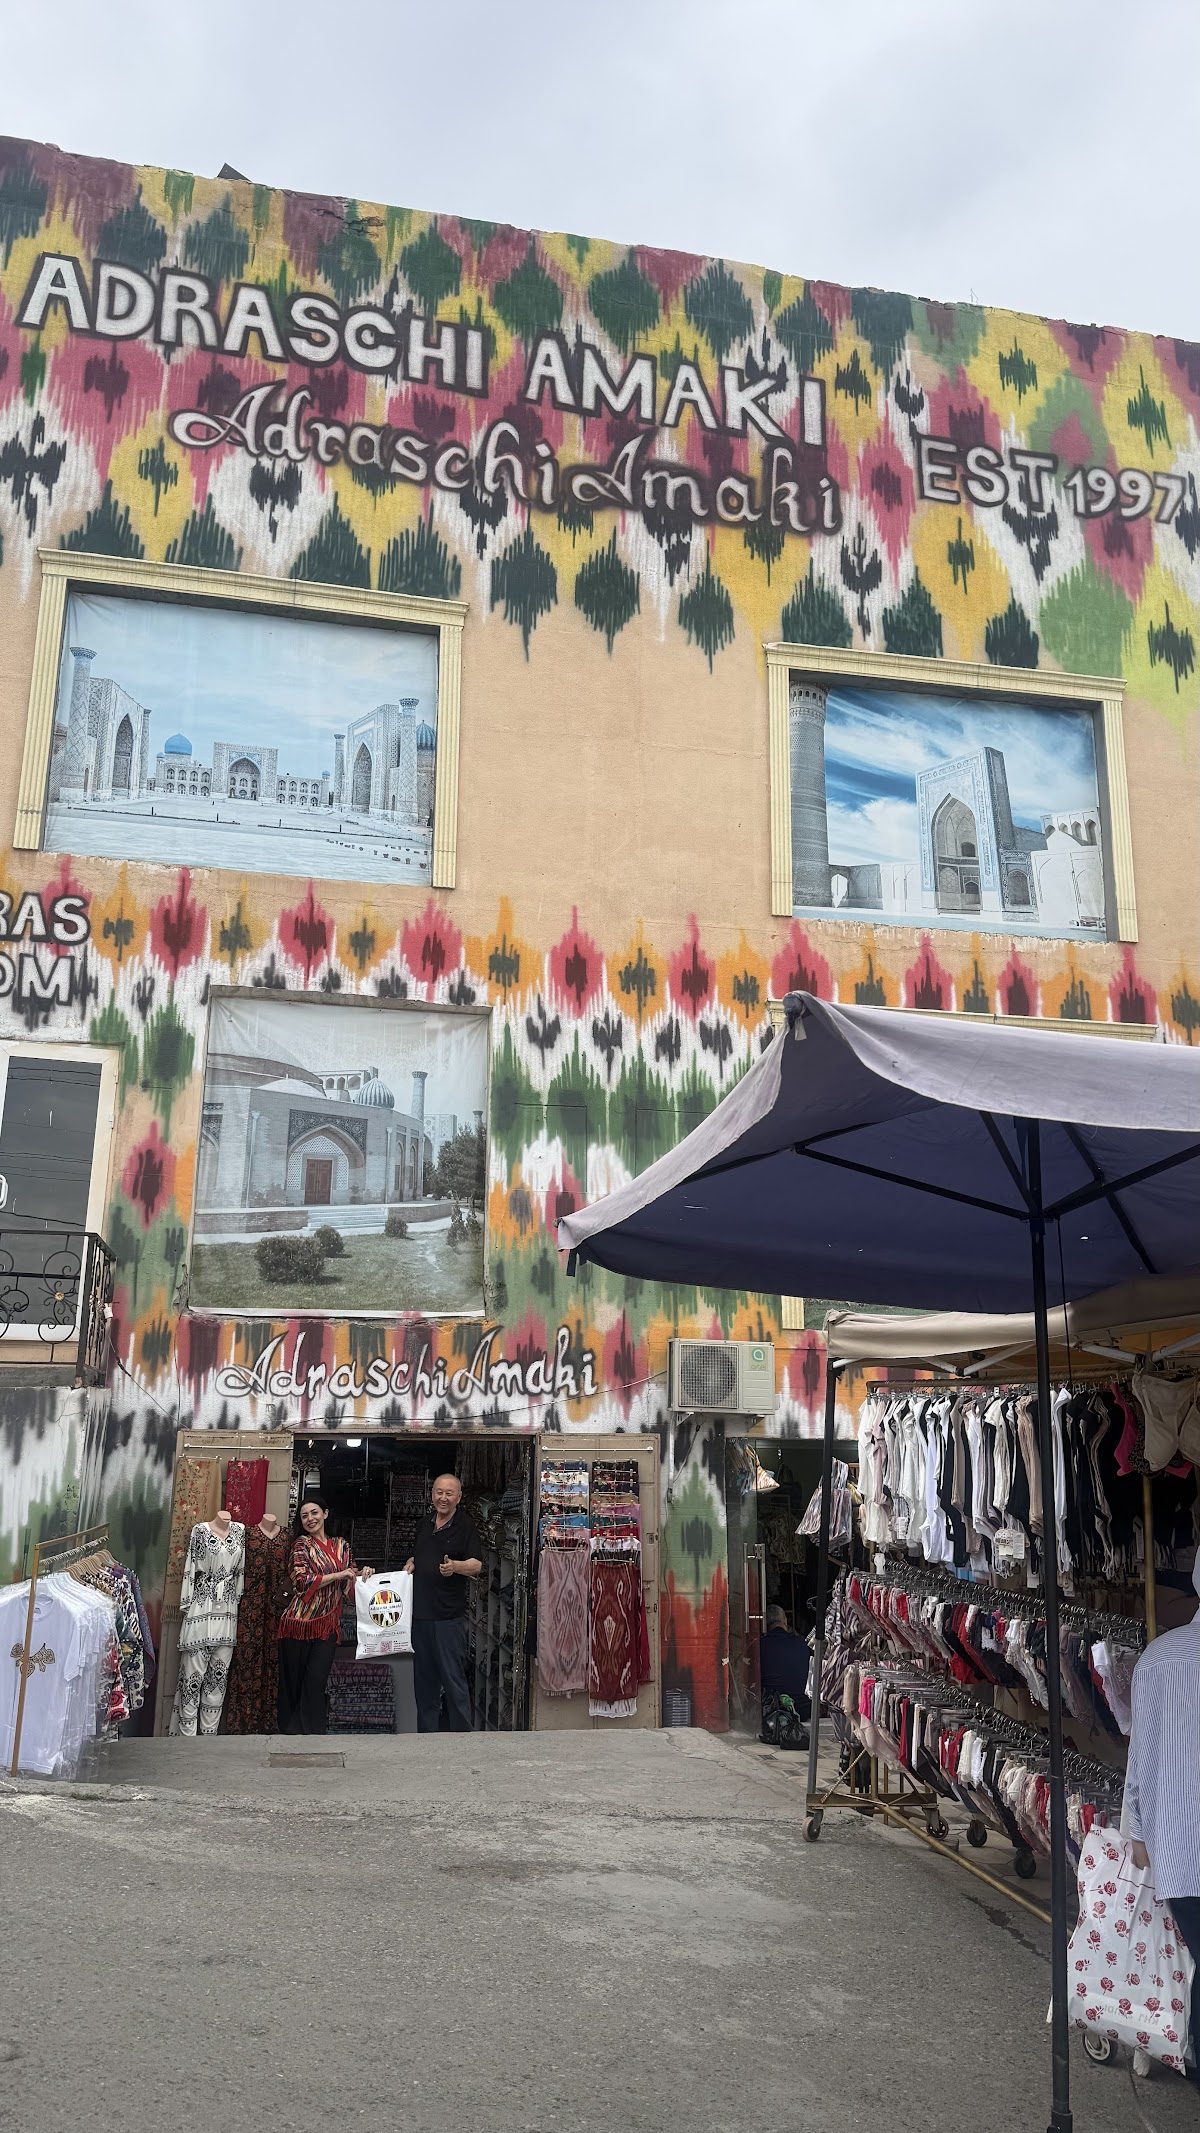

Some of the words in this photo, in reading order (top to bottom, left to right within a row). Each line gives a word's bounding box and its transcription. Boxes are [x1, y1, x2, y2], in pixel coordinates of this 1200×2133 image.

[16, 252, 488, 397] ADRASCHI
[523, 333, 826, 446] AMAKI
[169, 379, 556, 506] Adraschi
[570, 428, 840, 533] Amaki
[918, 435, 1057, 513] EST
[1063, 466, 1186, 524] 1997
